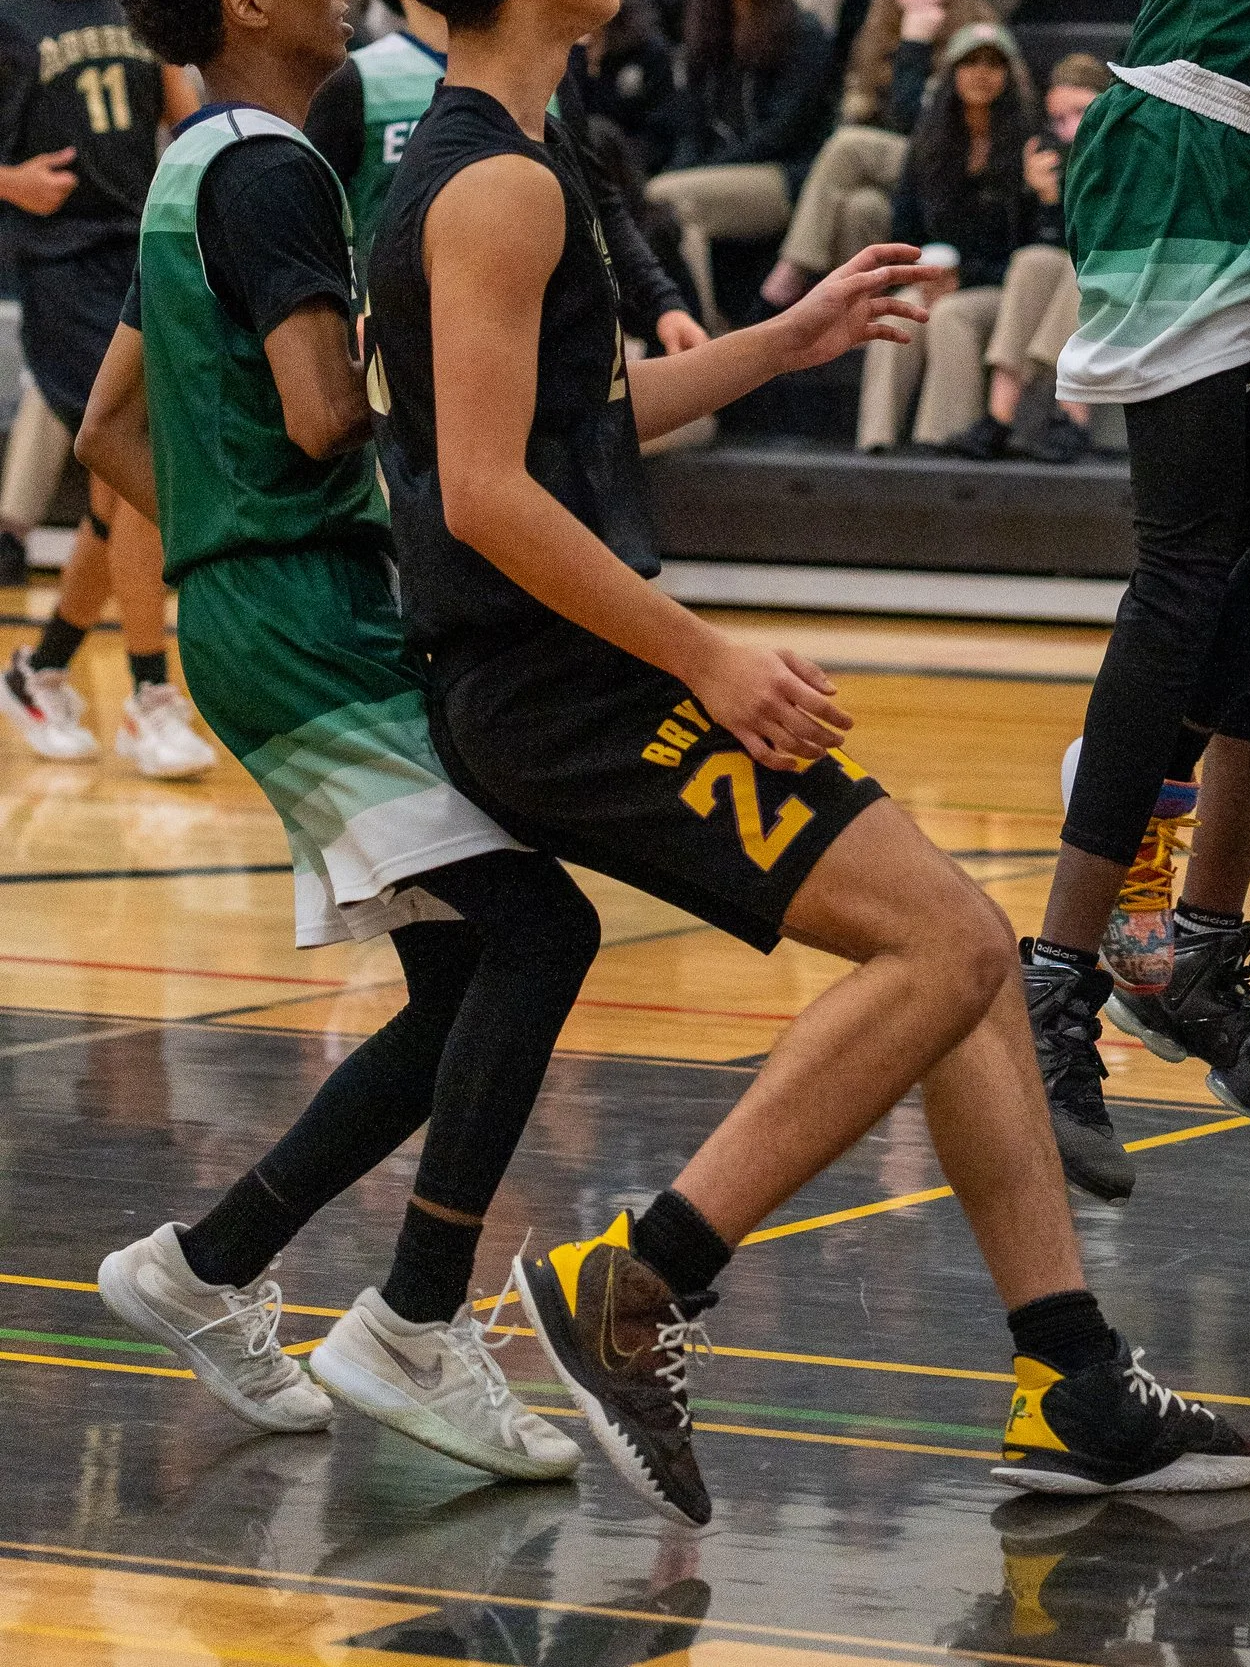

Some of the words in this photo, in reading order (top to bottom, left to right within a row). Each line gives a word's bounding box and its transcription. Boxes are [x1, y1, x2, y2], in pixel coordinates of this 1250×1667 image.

[76, 65, 131, 133] 11
[1190, 912, 1236, 925] adidas
[1037, 943, 1079, 961] adidas
